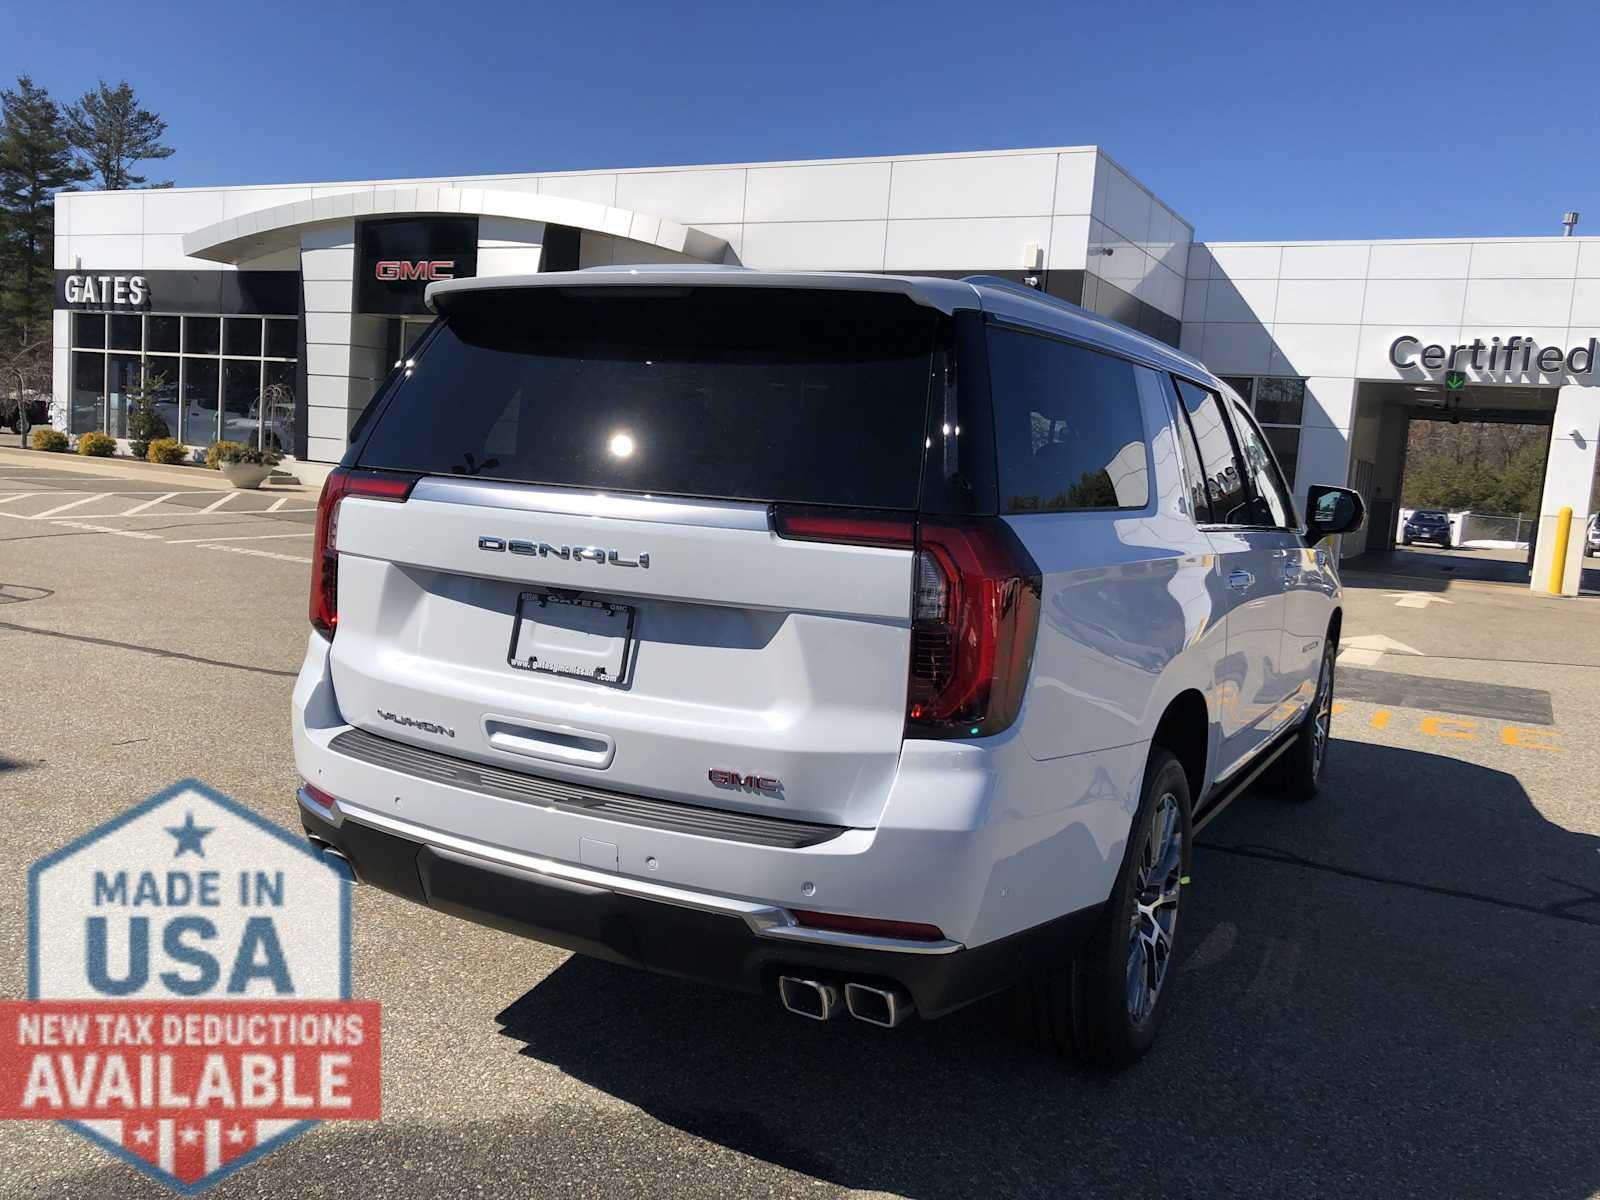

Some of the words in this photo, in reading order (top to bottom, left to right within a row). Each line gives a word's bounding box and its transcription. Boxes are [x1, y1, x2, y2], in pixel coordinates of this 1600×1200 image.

[375, 260, 455, 281] GMC
[64, 275, 146, 306] GATES
[1389, 335, 1597, 375] Certified
[478, 535, 650, 569] DENALI
[377, 708, 455, 738] YUKON
[708, 767, 783, 796] GMC
